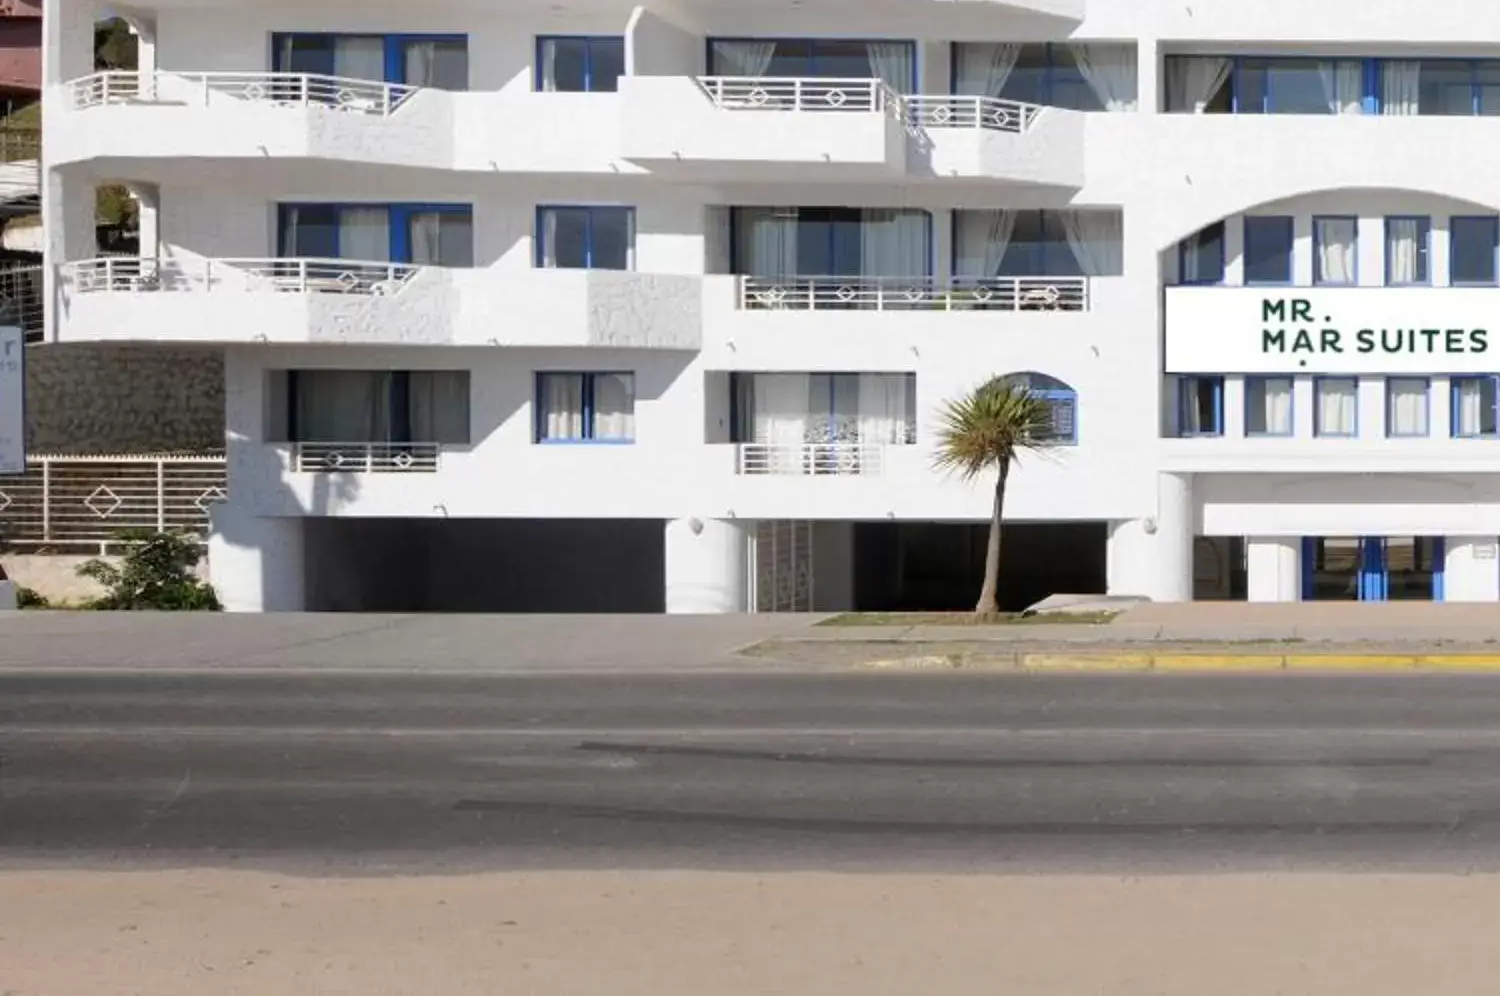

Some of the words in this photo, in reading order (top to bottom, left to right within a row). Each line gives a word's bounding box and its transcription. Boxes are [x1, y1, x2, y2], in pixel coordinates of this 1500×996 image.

[1262, 299, 1331, 323] MR.
[1262, 329, 1344, 353] MAR
[1356, 329, 1488, 353] SUITES
